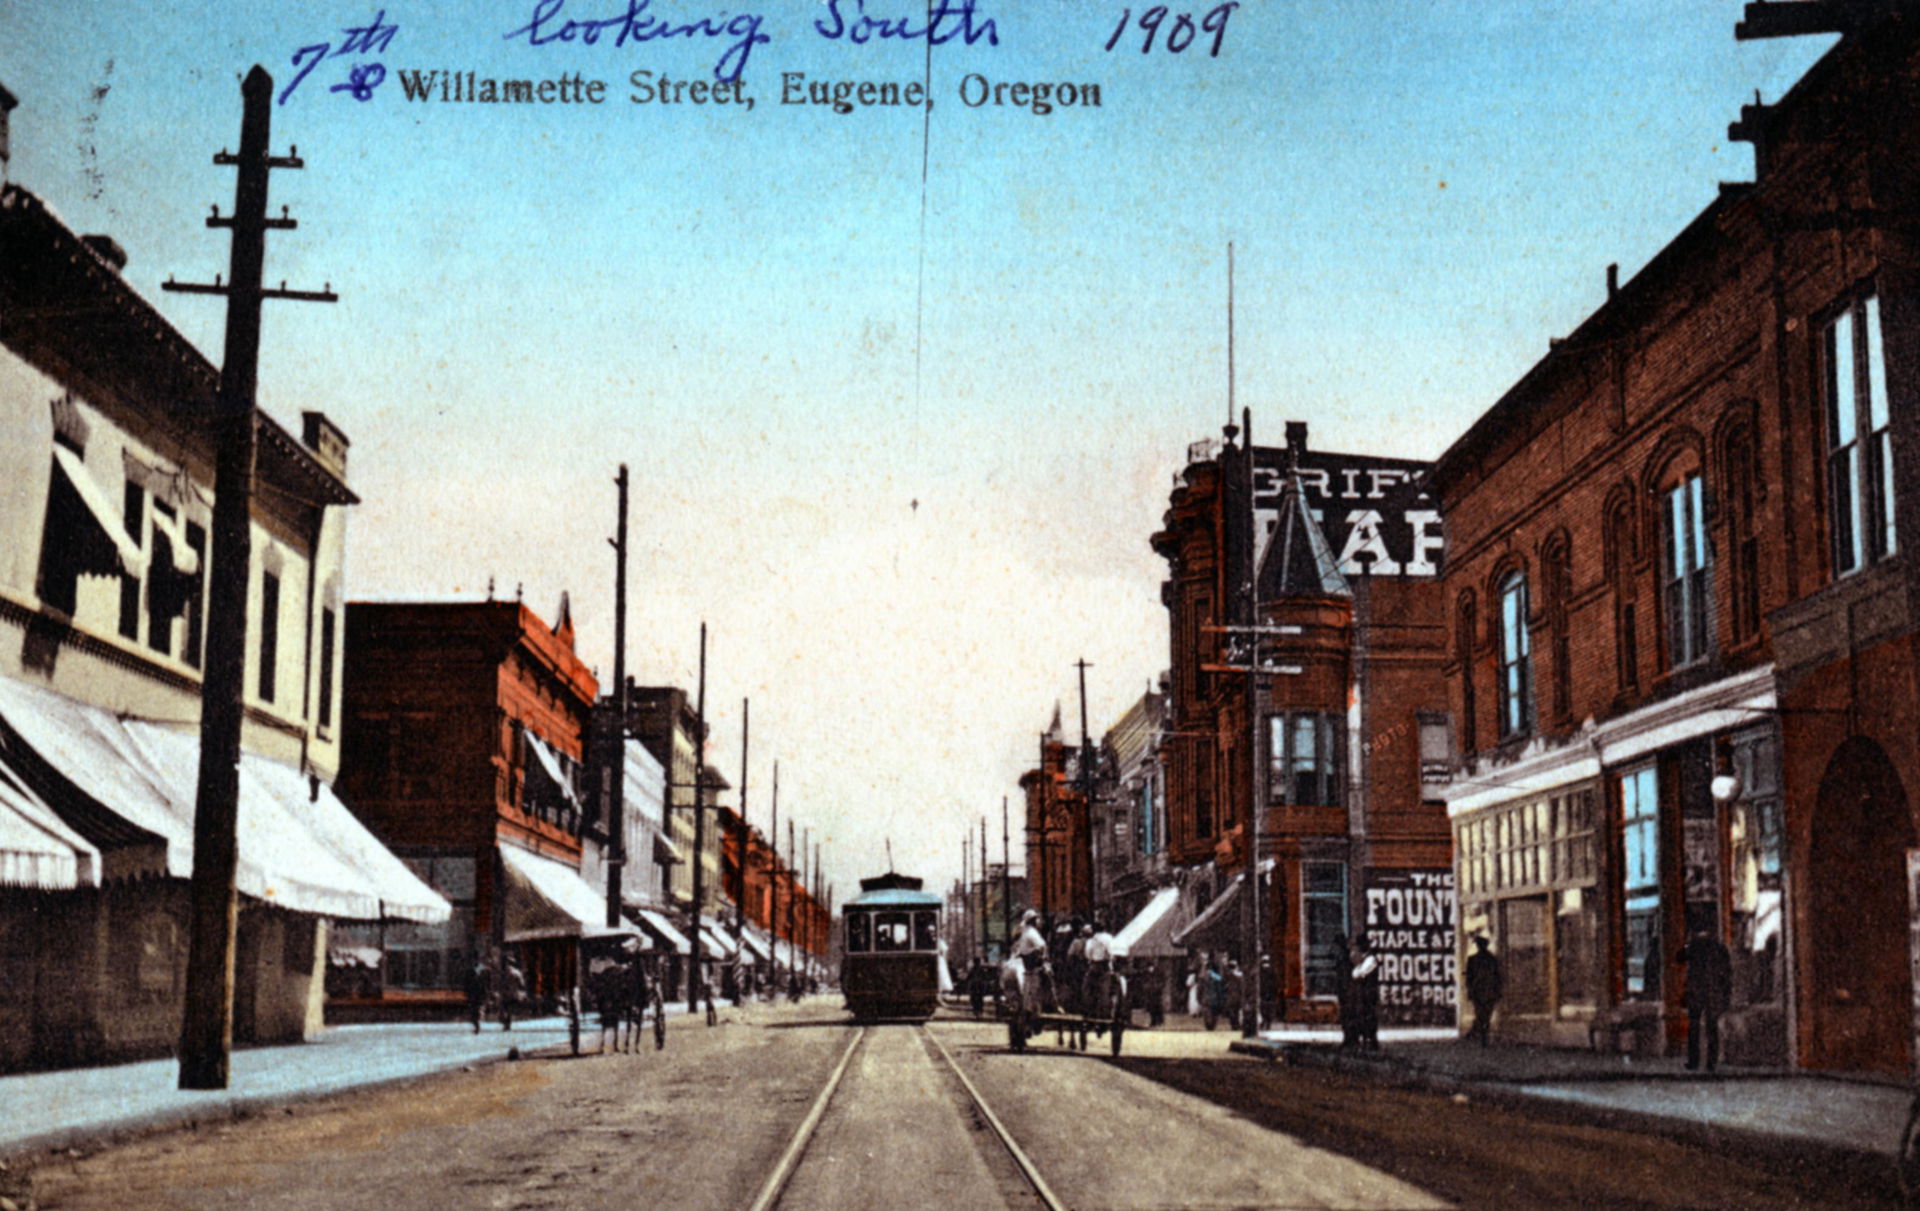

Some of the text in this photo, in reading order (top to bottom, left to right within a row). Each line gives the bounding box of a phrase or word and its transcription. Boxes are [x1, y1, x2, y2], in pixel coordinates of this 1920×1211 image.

[503, 0, 1240, 83] looking South 1909
[1367, 930, 1427, 949] STAPLE
